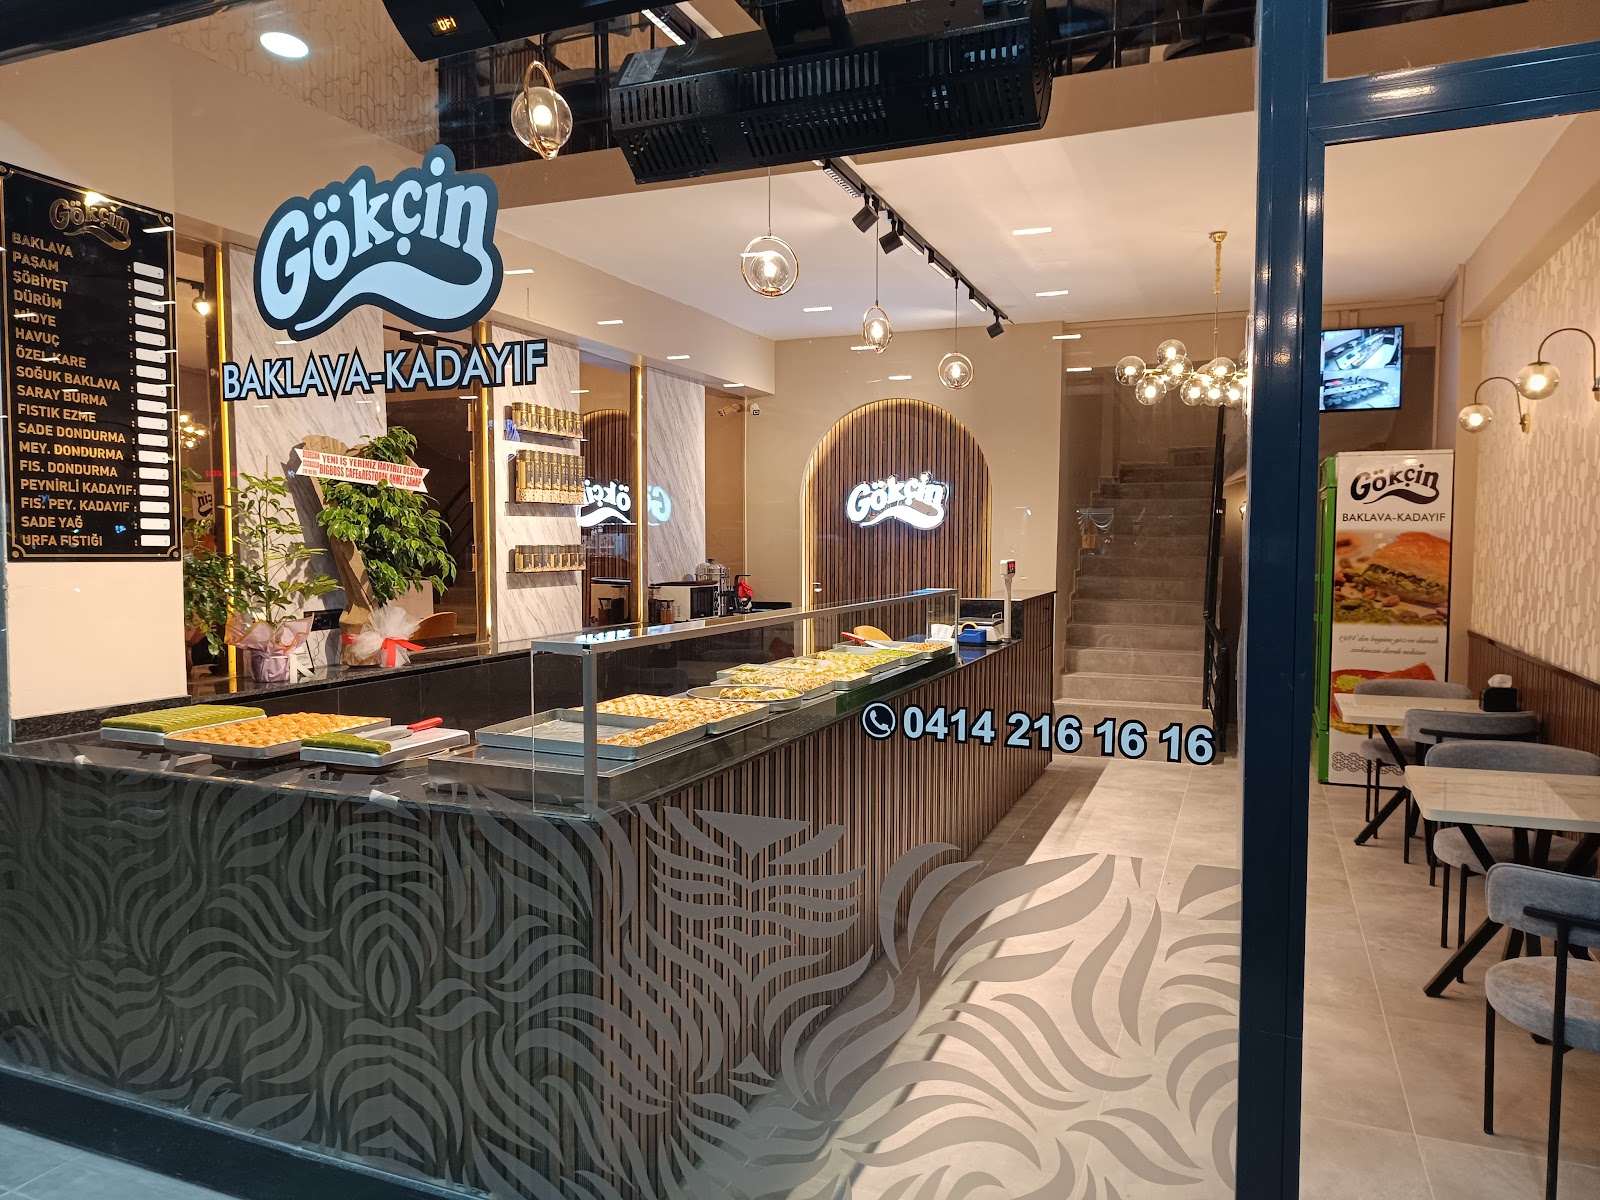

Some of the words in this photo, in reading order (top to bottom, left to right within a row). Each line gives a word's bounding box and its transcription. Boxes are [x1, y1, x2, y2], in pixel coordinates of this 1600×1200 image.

[50, 198, 131, 250] Gökçin
[12, 232, 73, 258] BAKLAVA
[260, 156, 494, 332] Gökçin
[12, 251, 59, 273] PAŞAM
[13, 270, 68, 293] ŞÖBİYET
[14, 289, 62, 310] DÜRÜM
[15, 327, 60, 348] HAVUÇ
[53, 353, 87, 369] KARE
[221, 340, 548, 402] BAKLAVA-KADAYIF
[16, 365, 62, 383] SOĞUK
[64, 372, 120, 391] BAKLAVA
[17, 385, 60, 400] SARAY
[63, 390, 107, 406] BURMA
[18, 403, 60, 419] FISTIK
[63, 409, 96, 423] EZME
[18, 422, 53, 436] SADE
[57, 426, 126, 443] DONDURMA
[19, 441, 50, 455] MEY.
[54, 443, 124, 461] DONDURMA
[48, 461, 118, 477] DONDURMA
[20, 478, 79, 493] PEYNİRLİ
[82, 482, 133, 496] KADAYIF
[1351, 464, 1440, 505] Gökçin
[80, 501, 130, 512] KADAYIF
[1342, 512, 1446, 522] BAKLAVA-KADAYIF
[21, 516, 56, 528] SADE
[58, 514, 83, 529] YAĞ
[22, 534, 57, 547] URFA
[60, 533, 103, 547] FISTIĞI
[901, 703, 997, 747] 0414
[1004, 710, 1083, 753] 216
[1093, 716, 1148, 760] 16
[1159, 719, 1217, 766] 16
